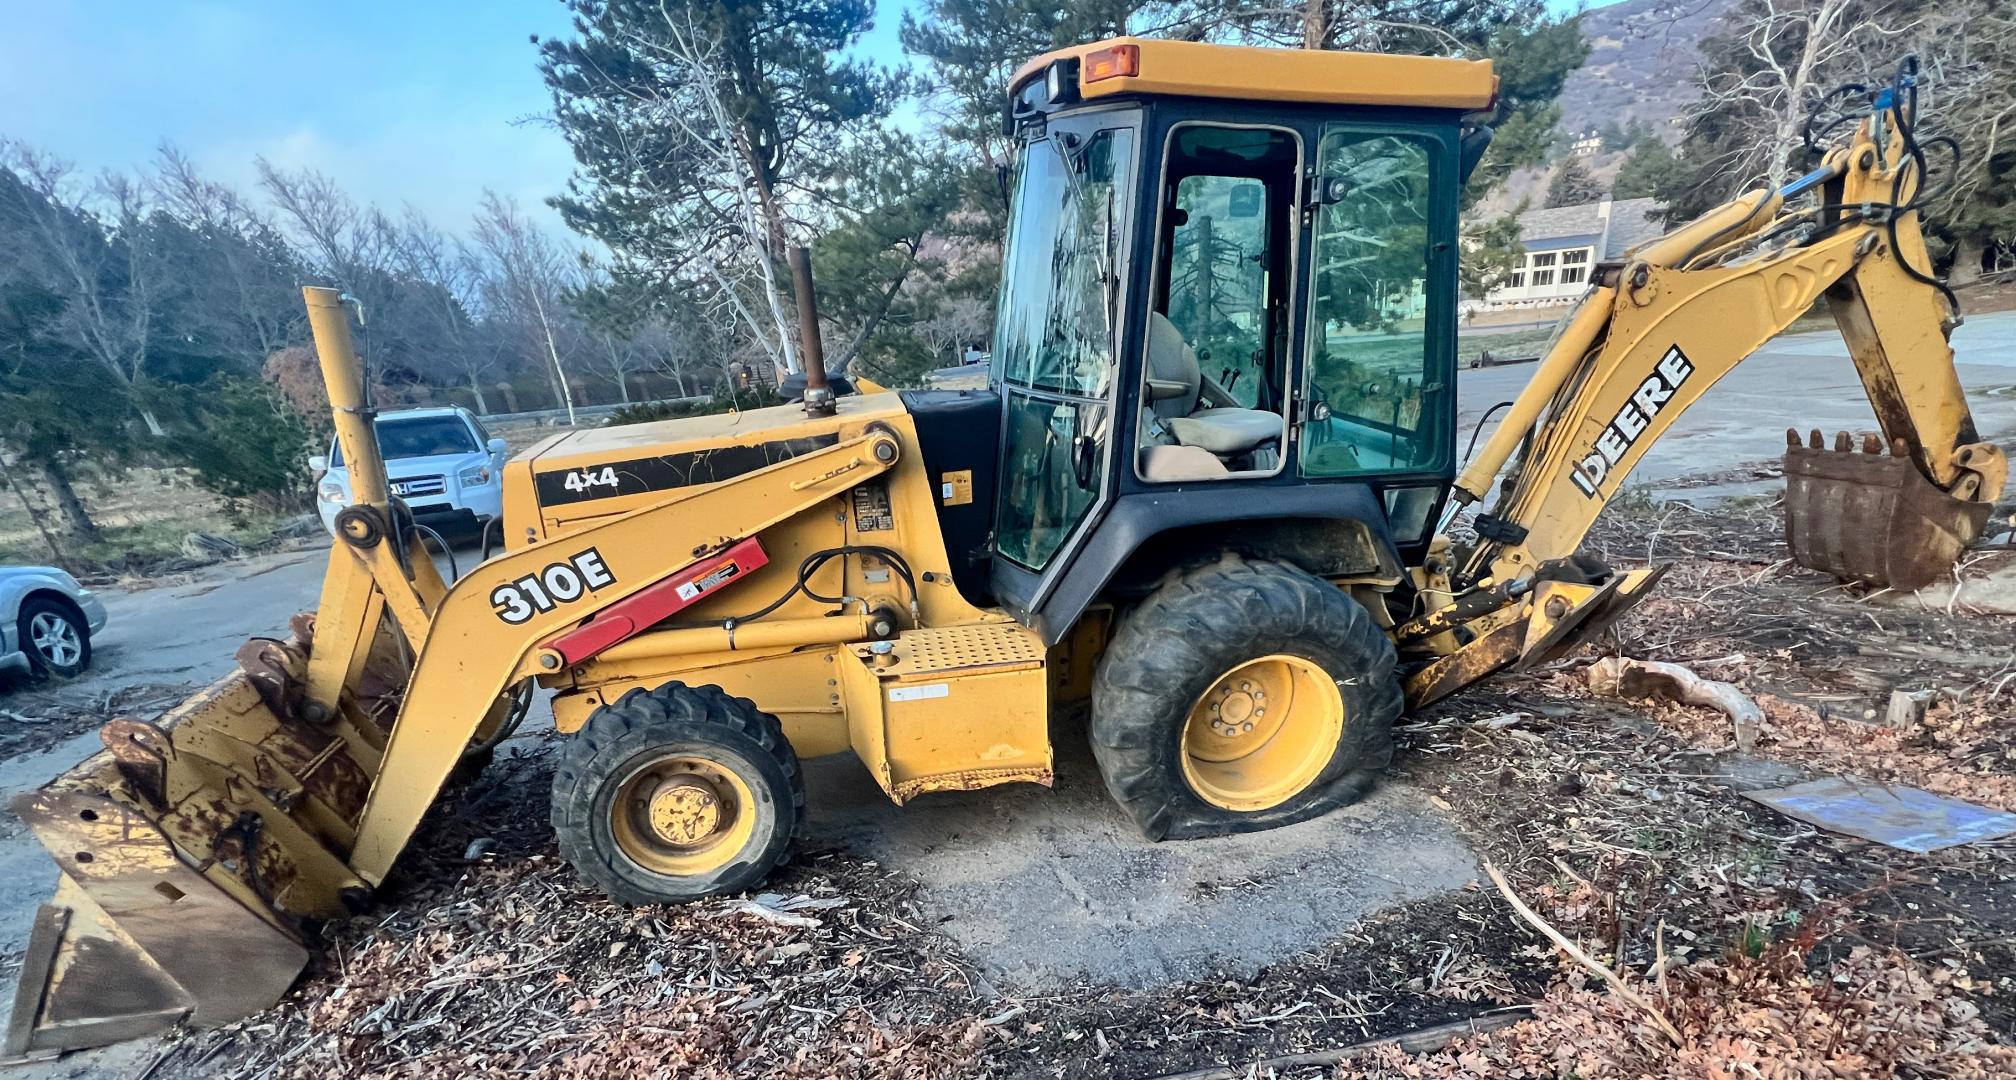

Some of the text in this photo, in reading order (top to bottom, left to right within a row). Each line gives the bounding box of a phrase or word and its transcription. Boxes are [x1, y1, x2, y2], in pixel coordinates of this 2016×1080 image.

[1572, 347, 1692, 497] DEERE
[564, 466, 619, 492] 4x4
[491, 547, 616, 624] 310E
